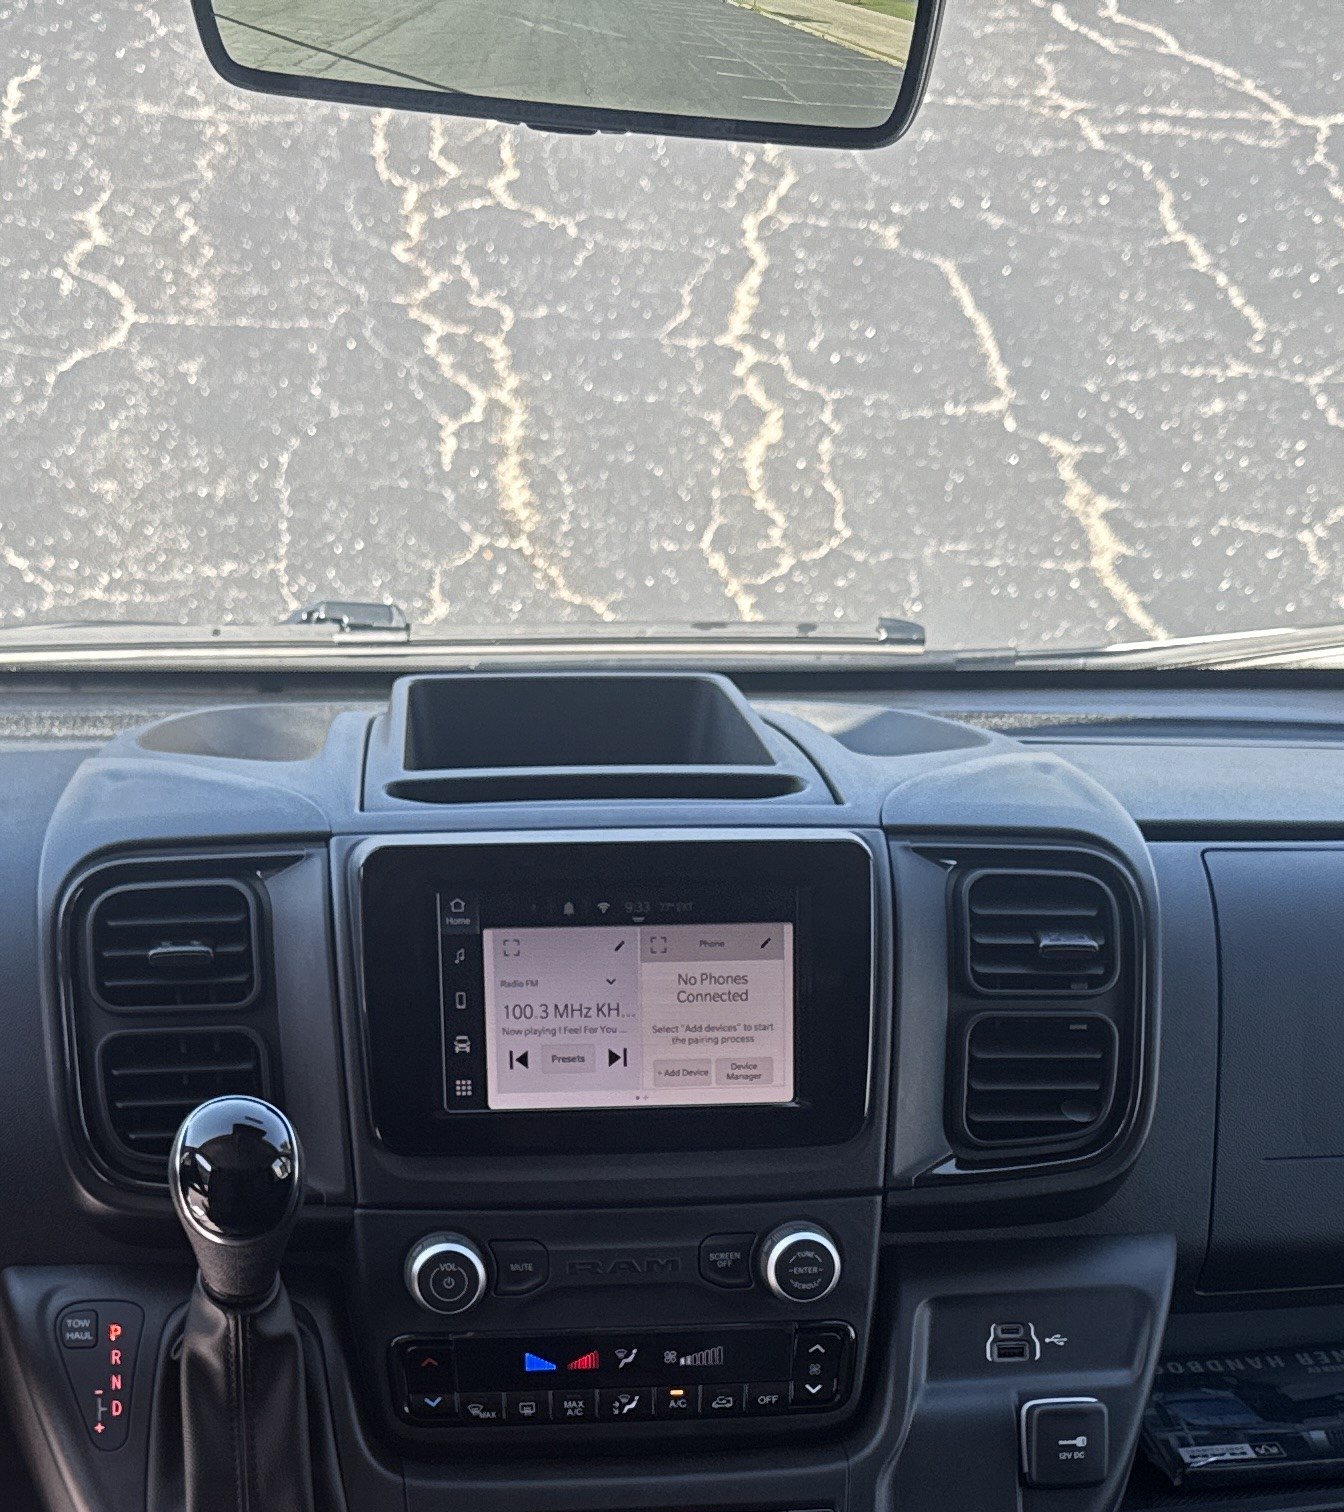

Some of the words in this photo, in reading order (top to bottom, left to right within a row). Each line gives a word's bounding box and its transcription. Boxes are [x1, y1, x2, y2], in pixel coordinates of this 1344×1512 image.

[446, 917, 471, 925] Home
[699, 939, 725, 948] Phone
[500, 979, 524, 988] Radio
[525, 979, 539, 988] FM
[677, 973, 697, 986] No
[700, 973, 749, 985] Phones
[677, 990, 749, 1003] Connected
[503, 1003, 549, 1020] 100.3
[553, 1003, 593, 1019] MHz
[502, 1027, 523, 1036] Now
[524, 1027, 557, 1038] playing
[563, 1026, 582, 1034] Feel
[584, 1026, 598, 1034] For
[599, 1025, 617, 1034] You
[652, 1024, 679, 1034] Select
[743, 1023, 753, 1032] to
[754, 1022, 774, 1032] start
[672, 1036, 687, 1045] the
[688, 1036, 719, 1046] pairing
[720, 1036, 755, 1045] process
[551, 1054, 586, 1063] Presets
[730, 1062, 758, 1071] Device
[664, 1069, 680, 1077] Add
[681, 1068, 709, 1077] Device
[726, 1073, 762, 1082] Manager
[709, 1252, 741, 1261] SCREEN
[439, 1263, 458, 1272] VOL
[510, 1263, 534, 1272] MUTE
[566, 1257, 681, 1276] RAM
[716, 1260, 733, 1268] OFF
[793, 1267, 818, 1275] ENTER
[66, 1319, 91, 1329] TOW
[65, 1331, 94, 1341] HAUL
[108, 1323, 123, 1341] P
[111, 1349, 122, 1365] R
[111, 1374, 123, 1390] N
[668, 1399, 688, 1408] A/C
[757, 1394, 779, 1404] OFF
[111, 1400, 123, 1416] D
[563, 1401, 586, 1409] MAX
[479, 1411, 497, 1419] MAX
[566, 1409, 584, 1417] A/C
[1059, 1451, 1073, 1460] 12V
[1074, 1451, 1085, 1459] DC
